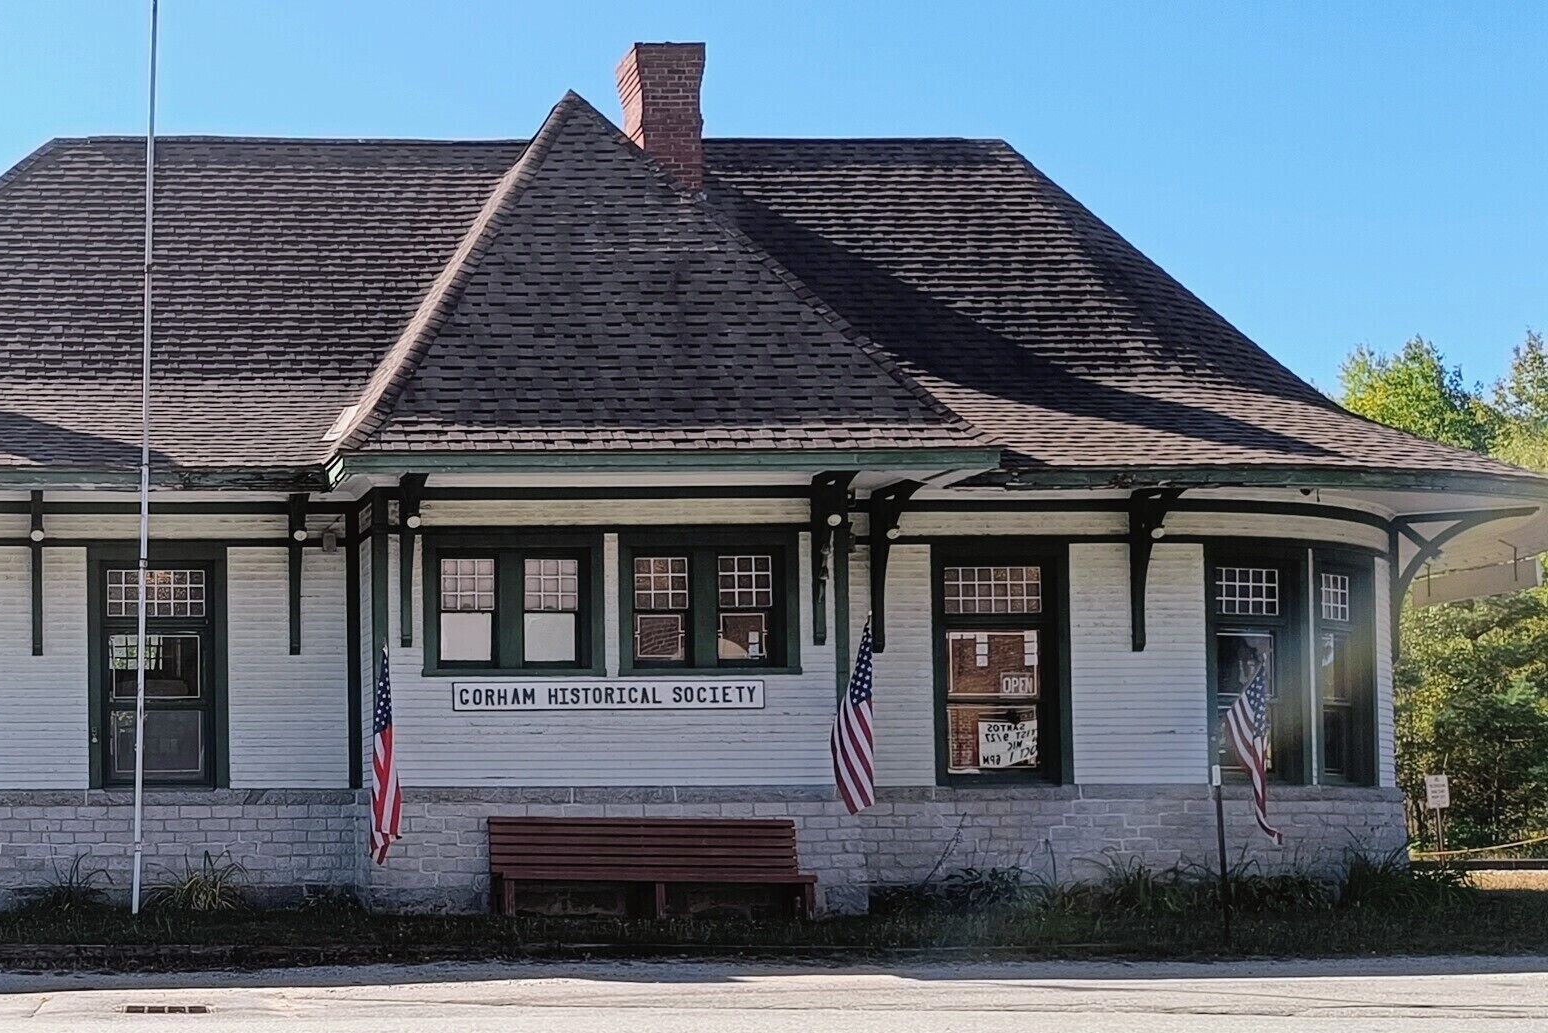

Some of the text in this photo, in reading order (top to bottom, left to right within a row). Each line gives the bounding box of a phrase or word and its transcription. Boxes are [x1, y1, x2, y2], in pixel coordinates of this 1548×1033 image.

[1002, 677, 1033, 694] OPEN
[459, 685, 756, 706] GORHAM HISTORICAL SOCIETY
